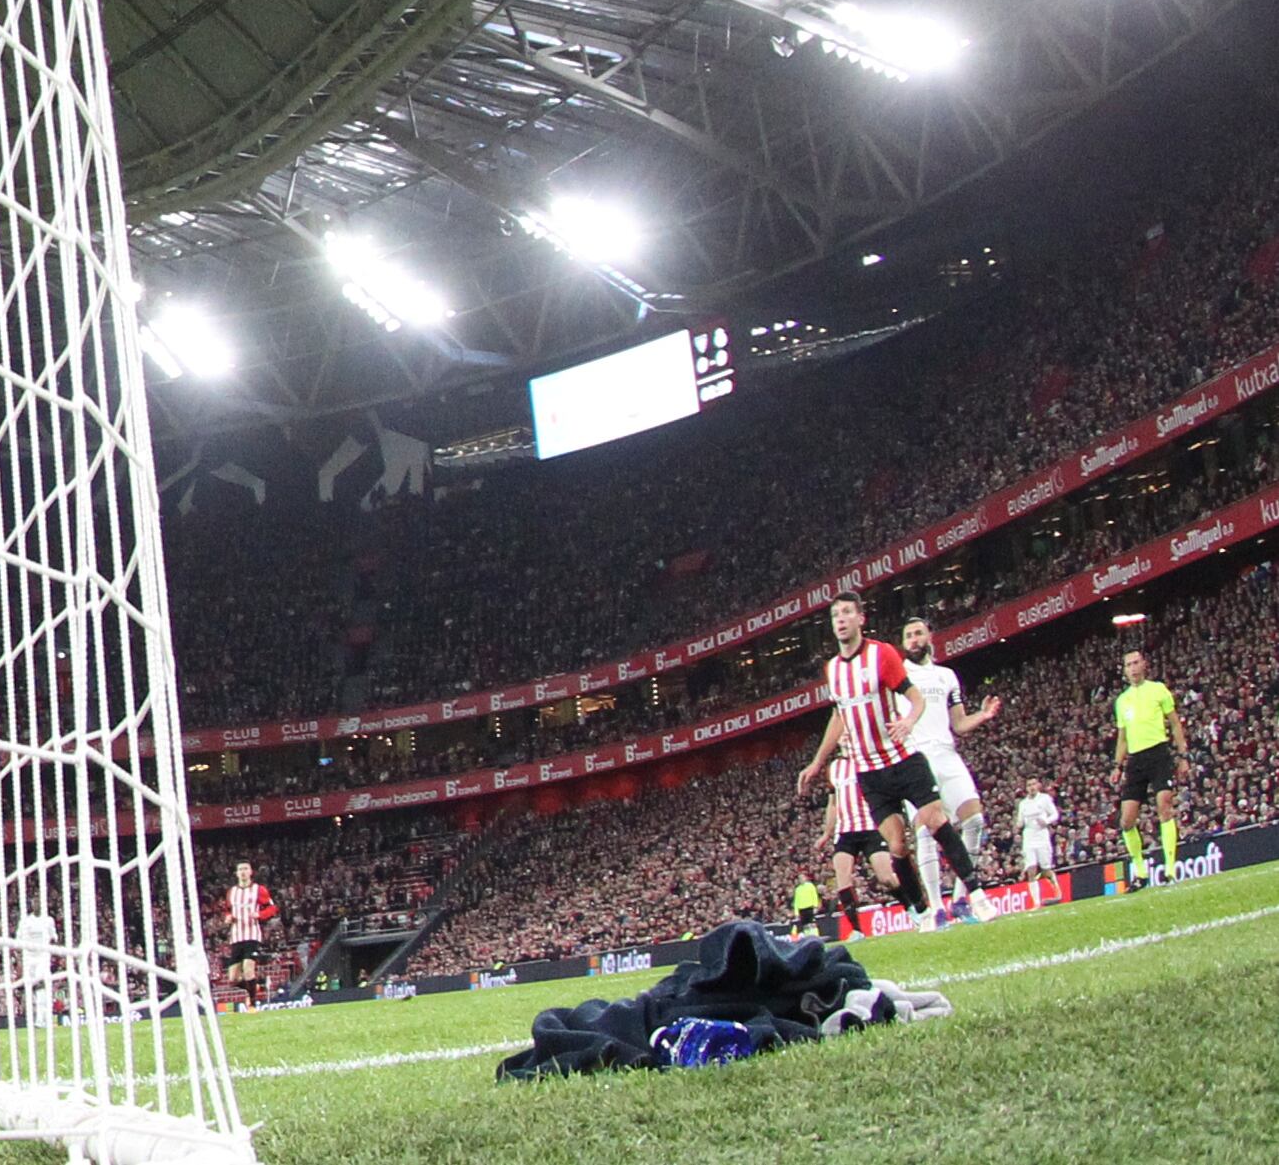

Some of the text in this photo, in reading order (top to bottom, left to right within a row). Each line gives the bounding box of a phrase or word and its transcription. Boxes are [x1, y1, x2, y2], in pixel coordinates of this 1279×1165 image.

[1234, 353, 1279, 400] kutxa
[1156, 392, 1208, 437] SanMiguel
[1080, 435, 1129, 477] SanMiguel
[1007, 477, 1055, 516] euskaltel
[937, 513, 980, 550] euskaltel
[1170, 520, 1224, 562] SanMiguel
[807, 539, 928, 608] IMQ IMQ IMQ IMQ
[1093, 555, 1141, 594] SanMiguel
[747, 598, 801, 632] DIGI DIGI
[1017, 591, 1066, 627] euskaltel
[687, 625, 742, 656] DIGI DIGI
[945, 621, 988, 656] euskaltel
[755, 692, 811, 722] DIGI DIGI
[815, 684, 831, 703] IM
[223, 727, 260, 740] CLUB
[281, 721, 318, 734] CLUB
[694, 714, 750, 741] DIGI DIGI
[224, 804, 261, 817] CLUB
[284, 797, 322, 811] CLUB
[1129, 842, 1223, 887] Micosoft
[887, 911, 913, 932] LaLi
